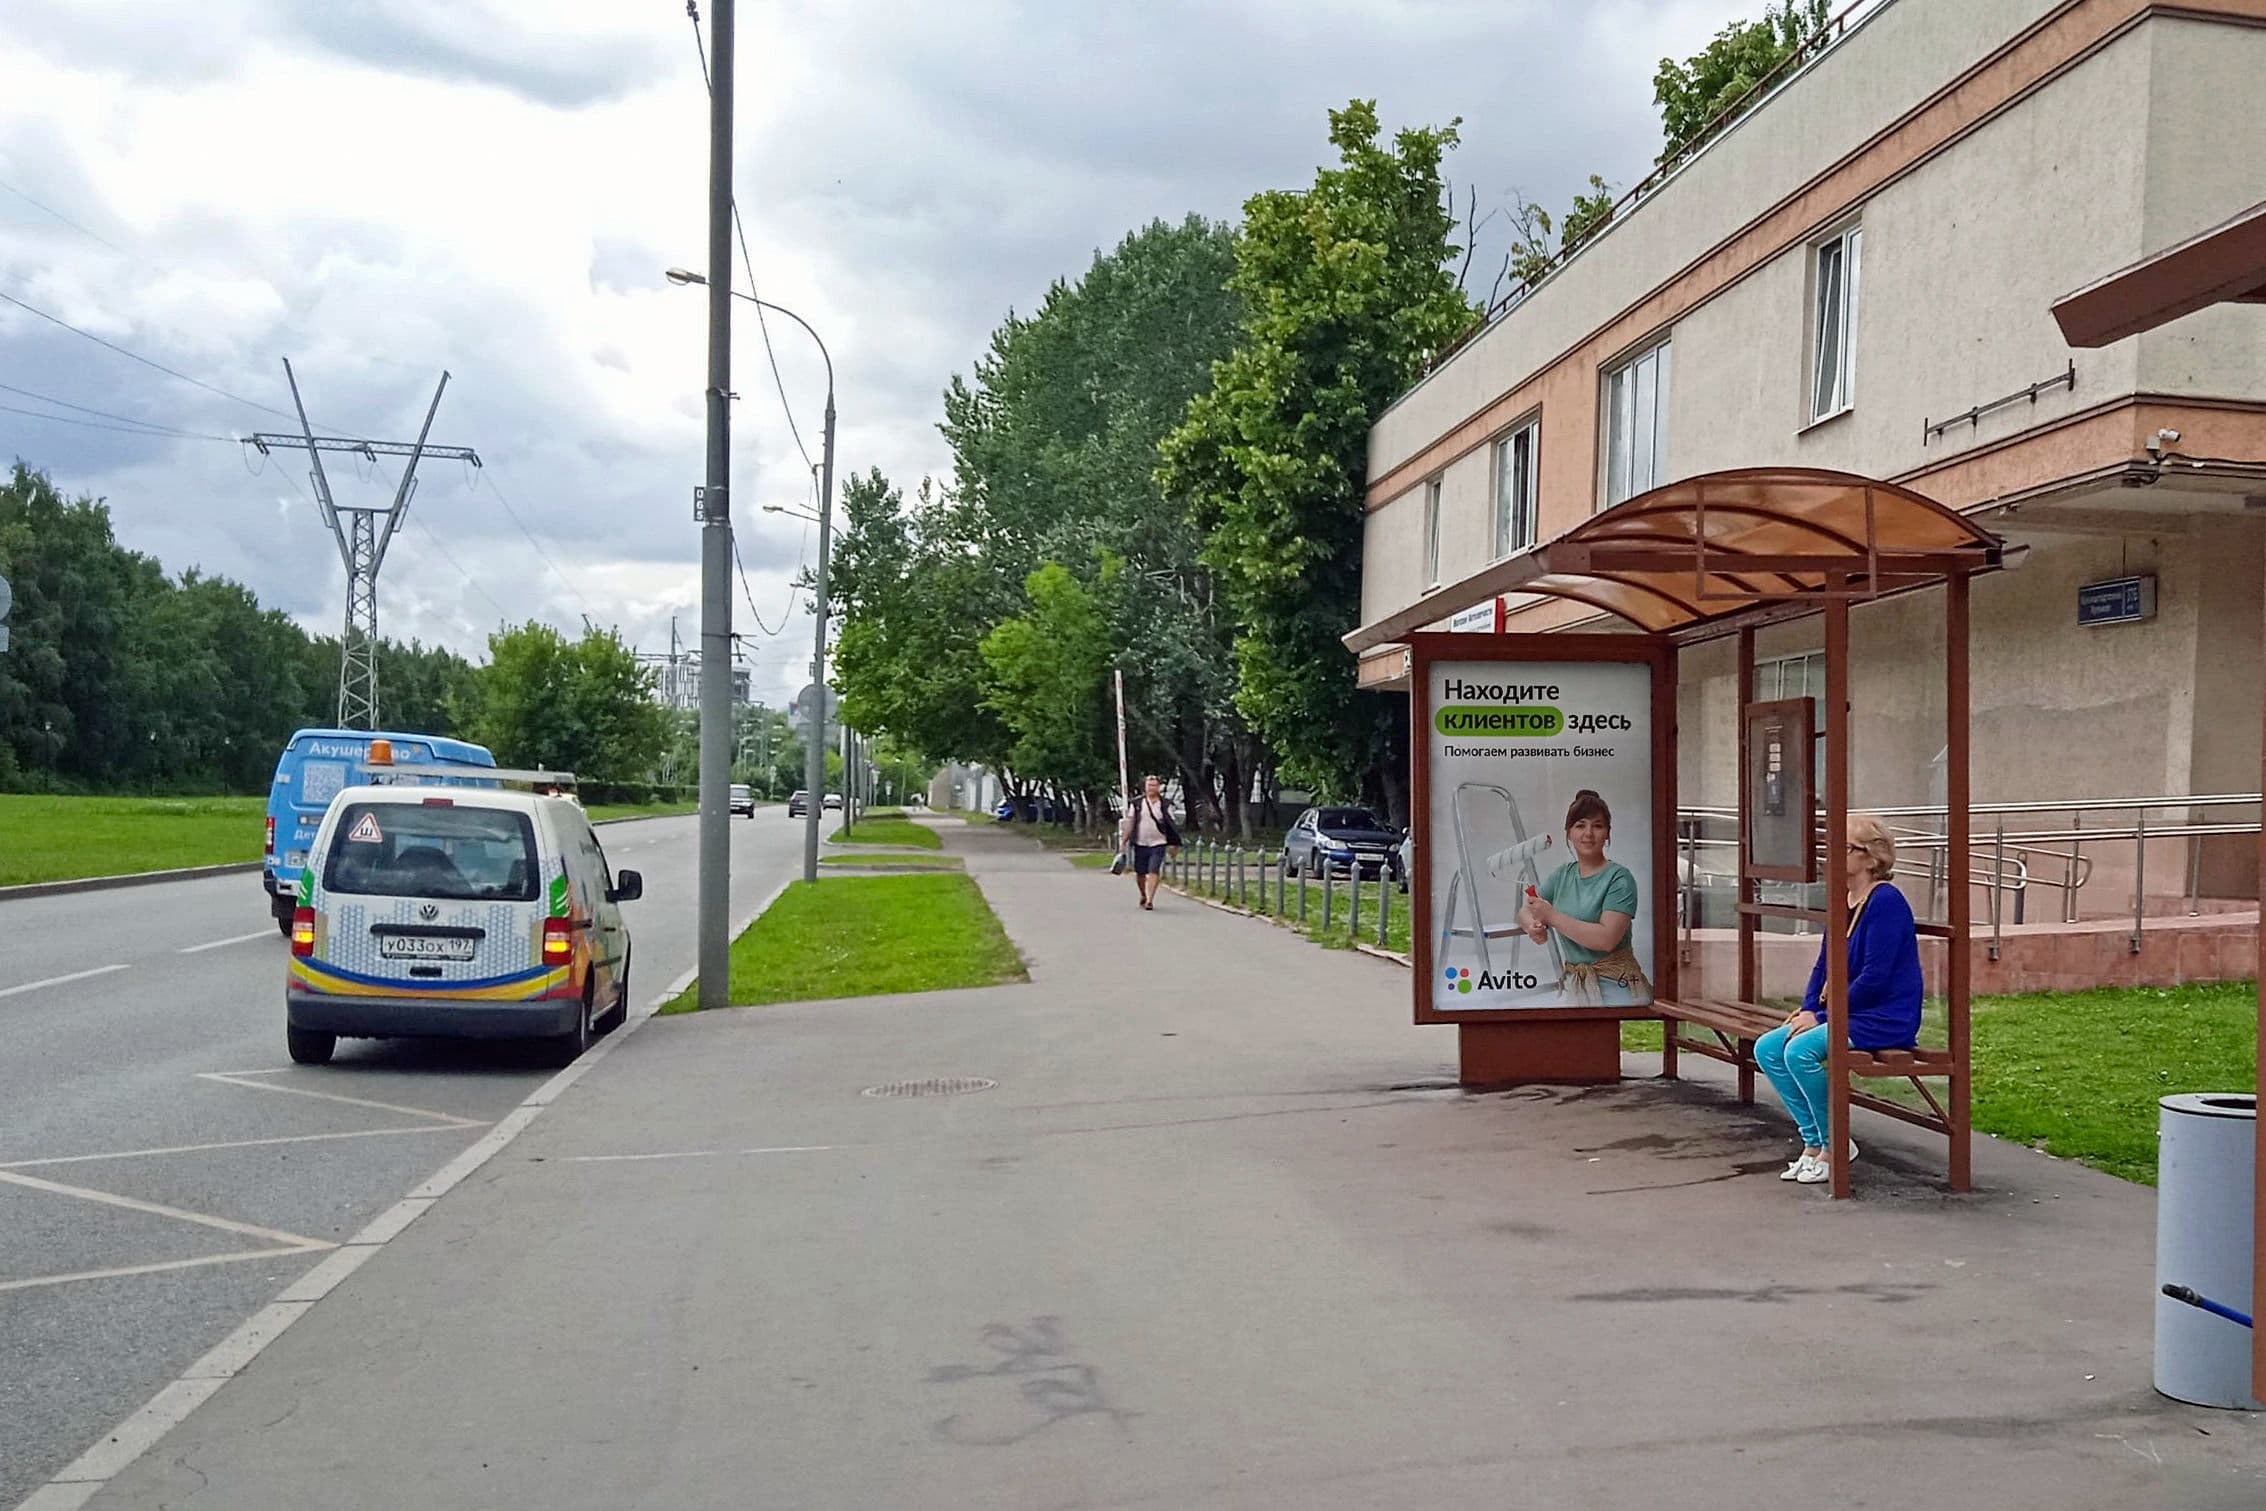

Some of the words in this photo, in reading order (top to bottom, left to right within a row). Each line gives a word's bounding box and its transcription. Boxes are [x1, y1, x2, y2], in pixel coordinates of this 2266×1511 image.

[1444, 679, 1560, 704] Находите
[1444, 713, 1556, 730] клиентов
[1568, 713, 1632, 734] здесь
[309, 741, 411, 760] Акушерво
[1444, 745, 1507, 757] Помогаем
[1510, 747, 1570, 759] развивать
[1573, 745, 1615, 757] бизнес
[1477, 970, 1538, 990] Avito
[1617, 972, 1639, 988] 6+
